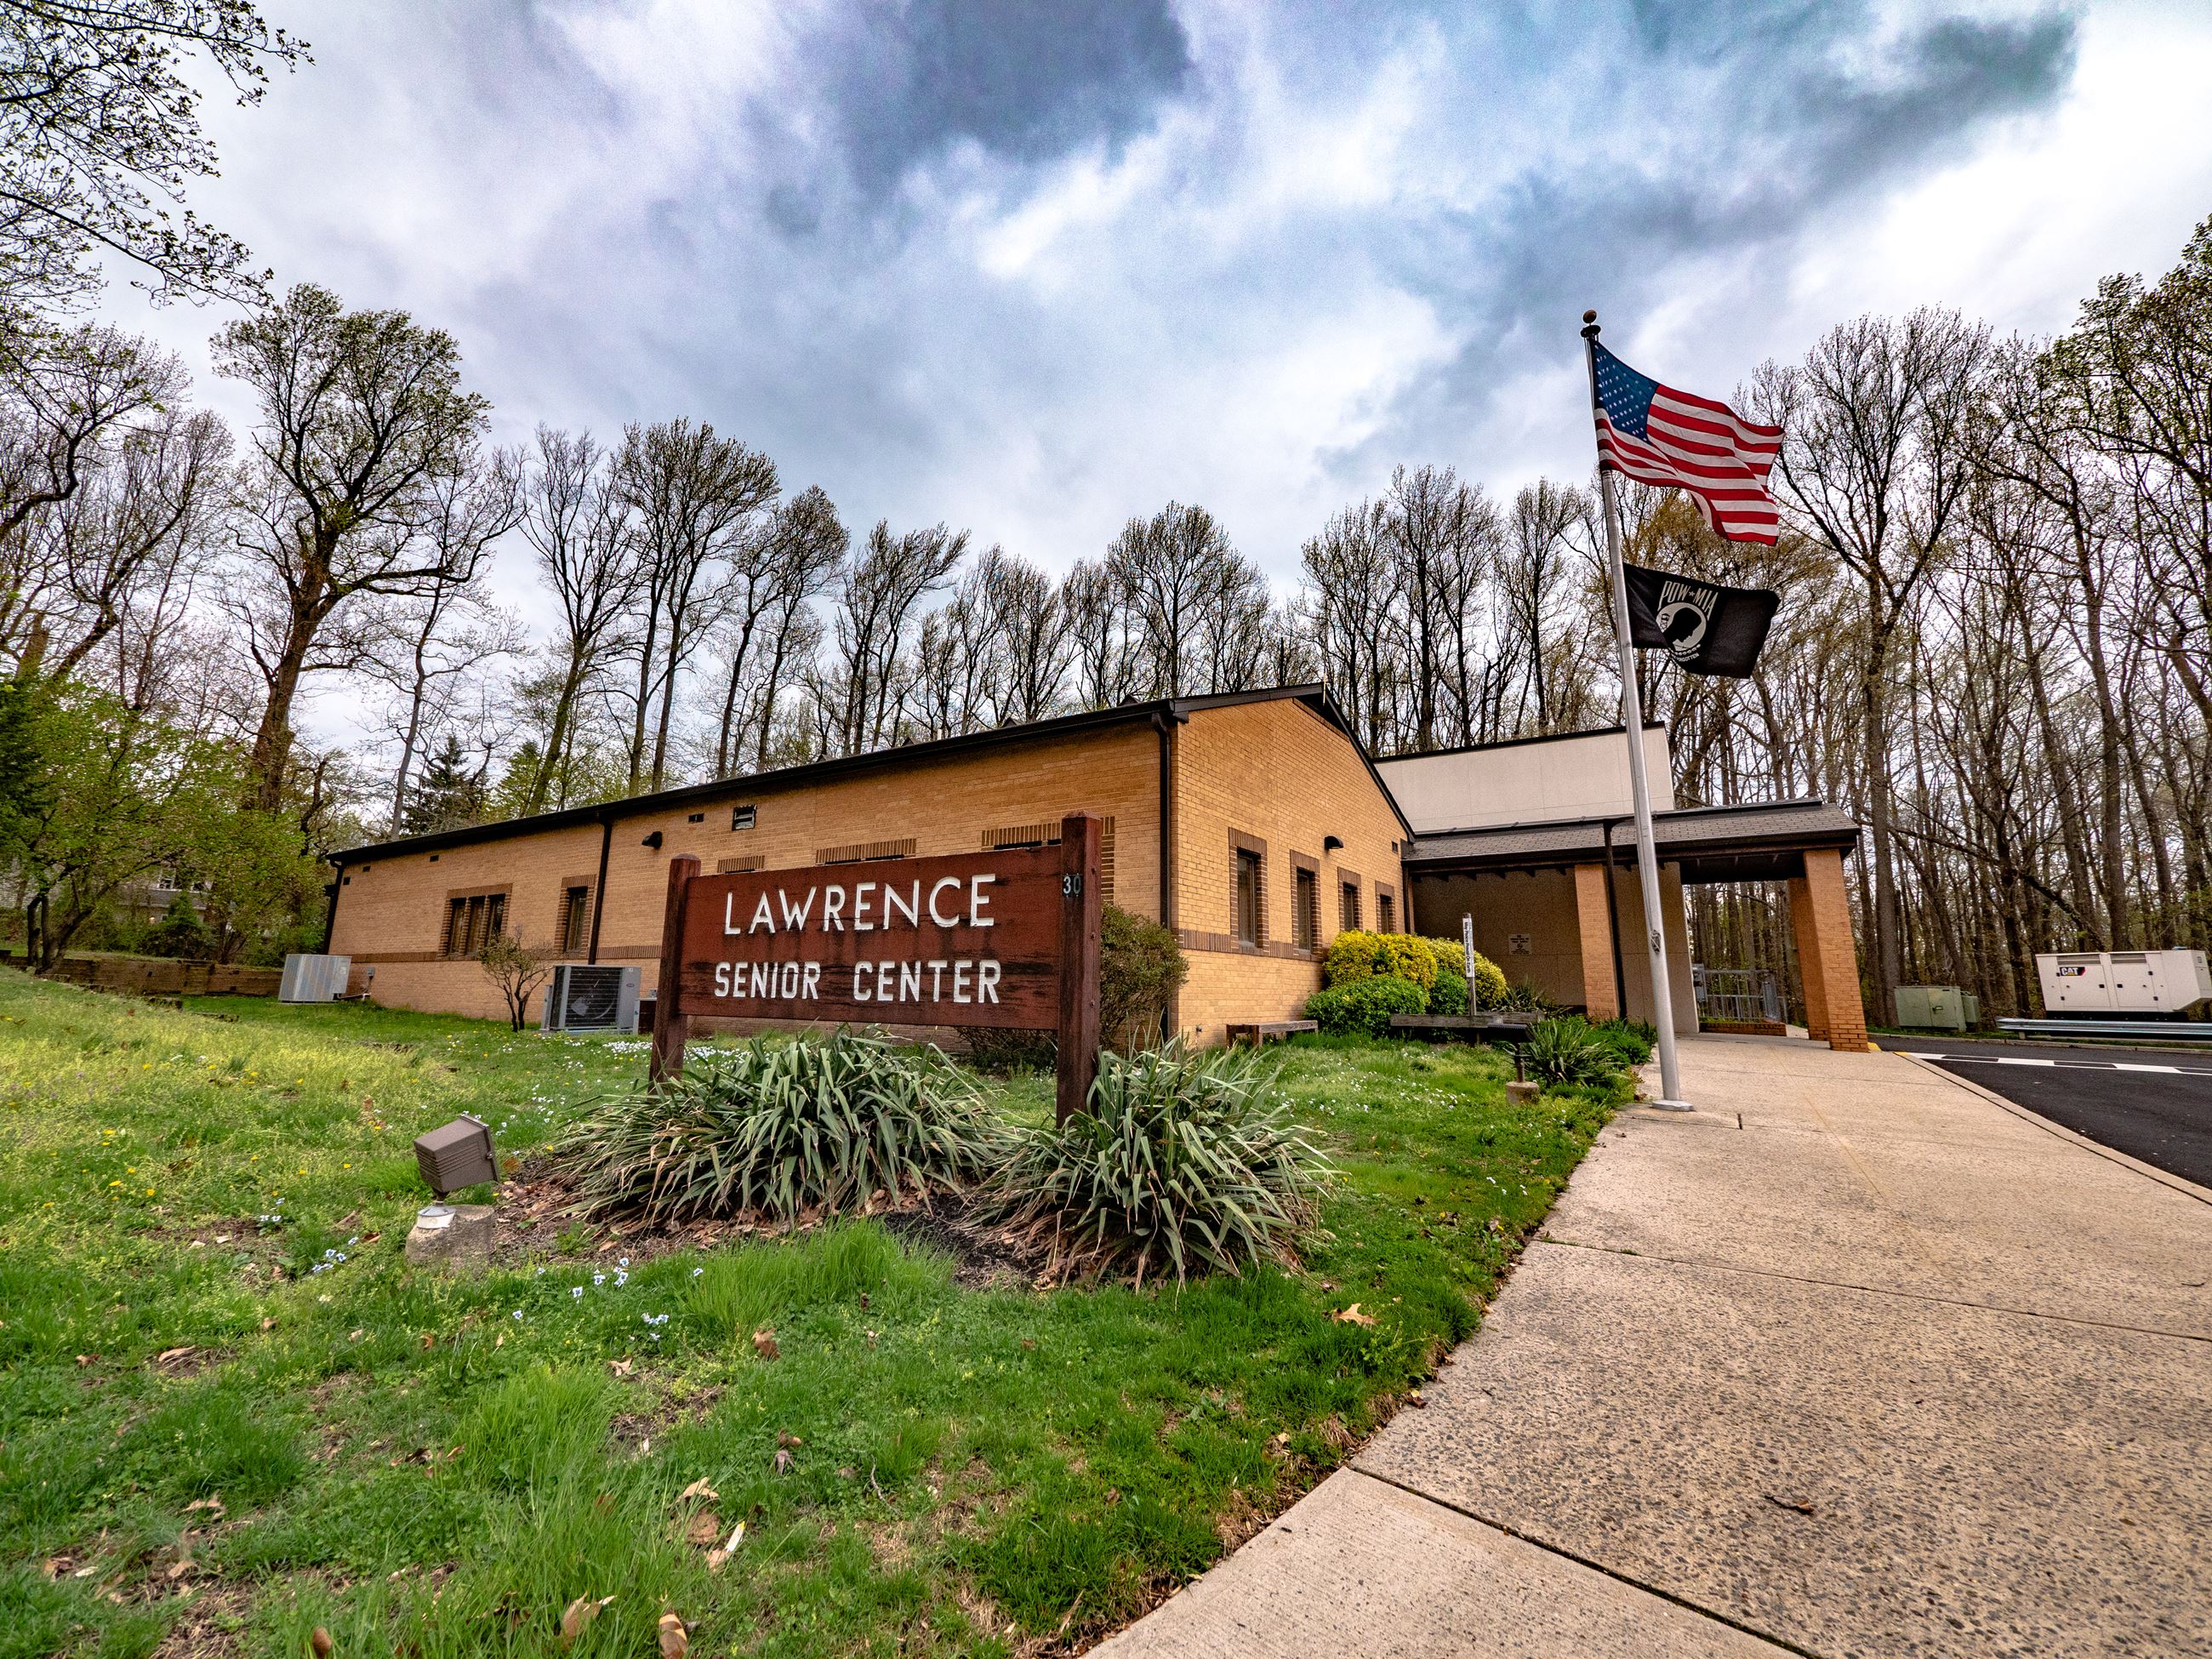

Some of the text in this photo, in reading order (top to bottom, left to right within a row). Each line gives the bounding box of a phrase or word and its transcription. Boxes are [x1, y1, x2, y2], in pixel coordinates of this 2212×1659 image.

[724, 874, 996, 935] LAWRENCE
[1063, 875, 1081, 894] 30
[714, 960, 1001, 1004] SENIOR CENTER
